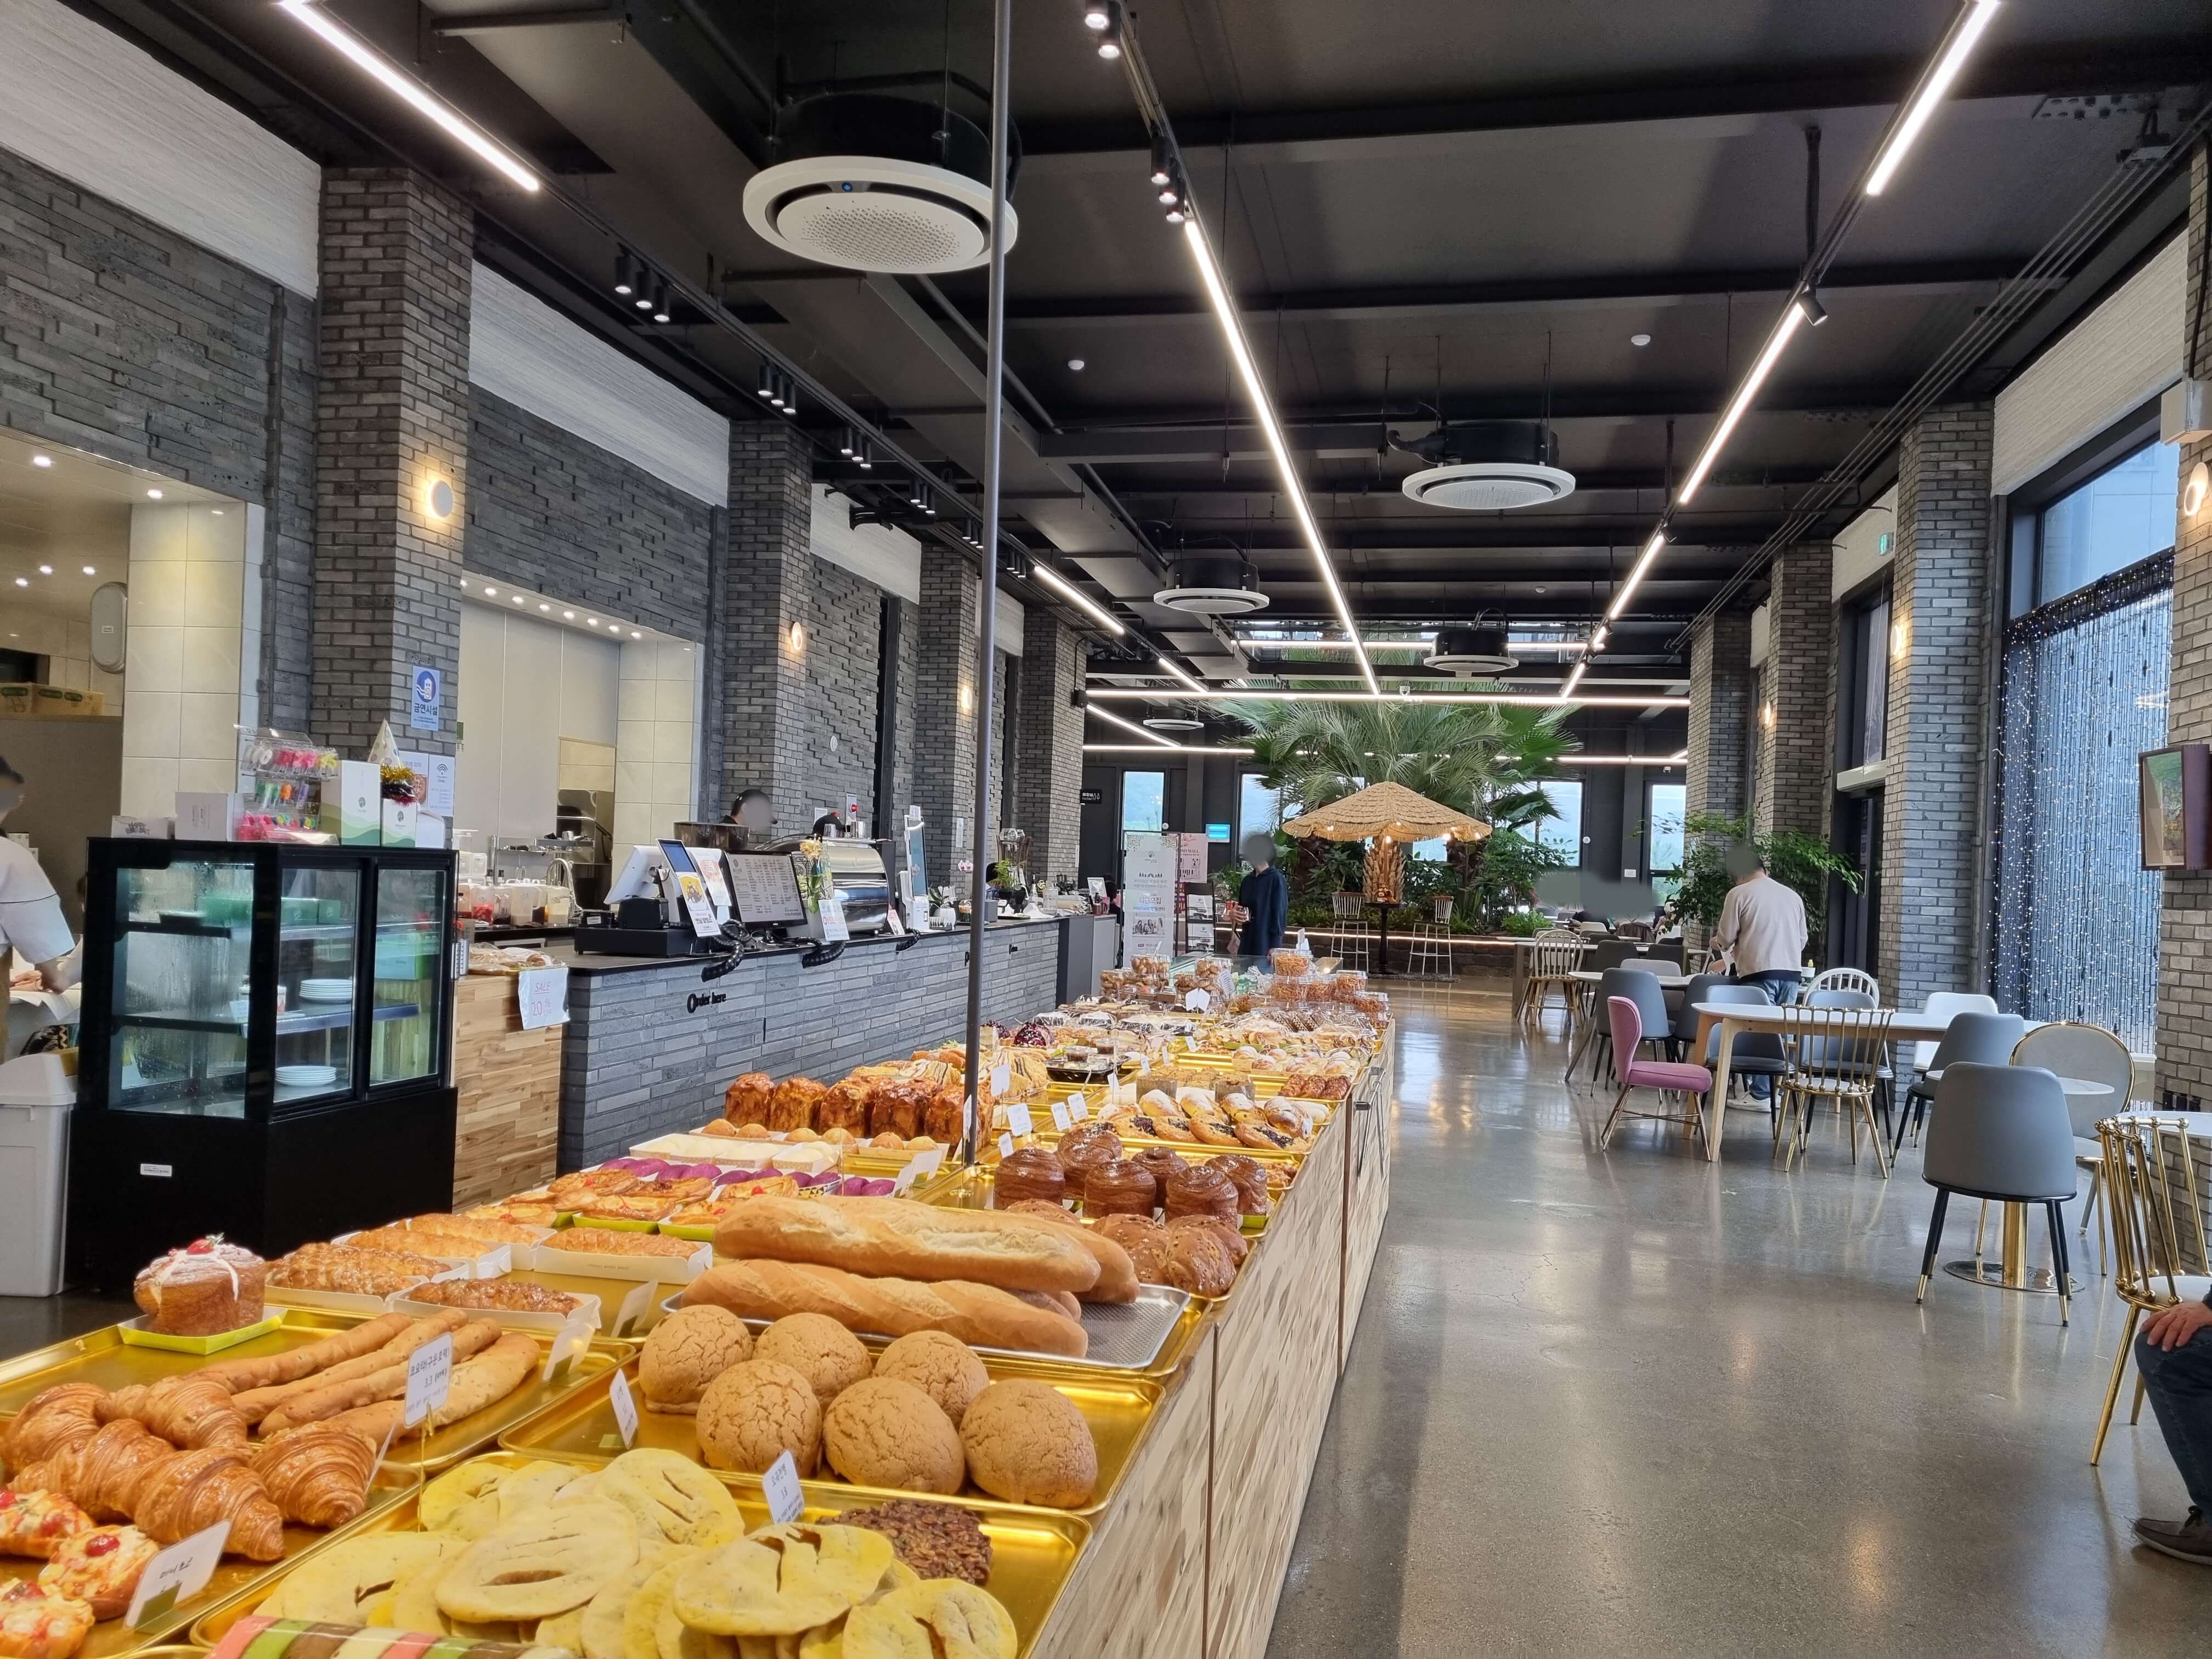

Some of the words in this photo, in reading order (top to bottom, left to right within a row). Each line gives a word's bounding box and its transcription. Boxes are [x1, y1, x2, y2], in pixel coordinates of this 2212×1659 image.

[414, 703, 438, 716] 금연시설
[535, 981, 551, 992] SALE
[531, 1001, 542, 1016] 20
[687, 993, 710, 1013] Order
[712, 991, 726, 1005] here
